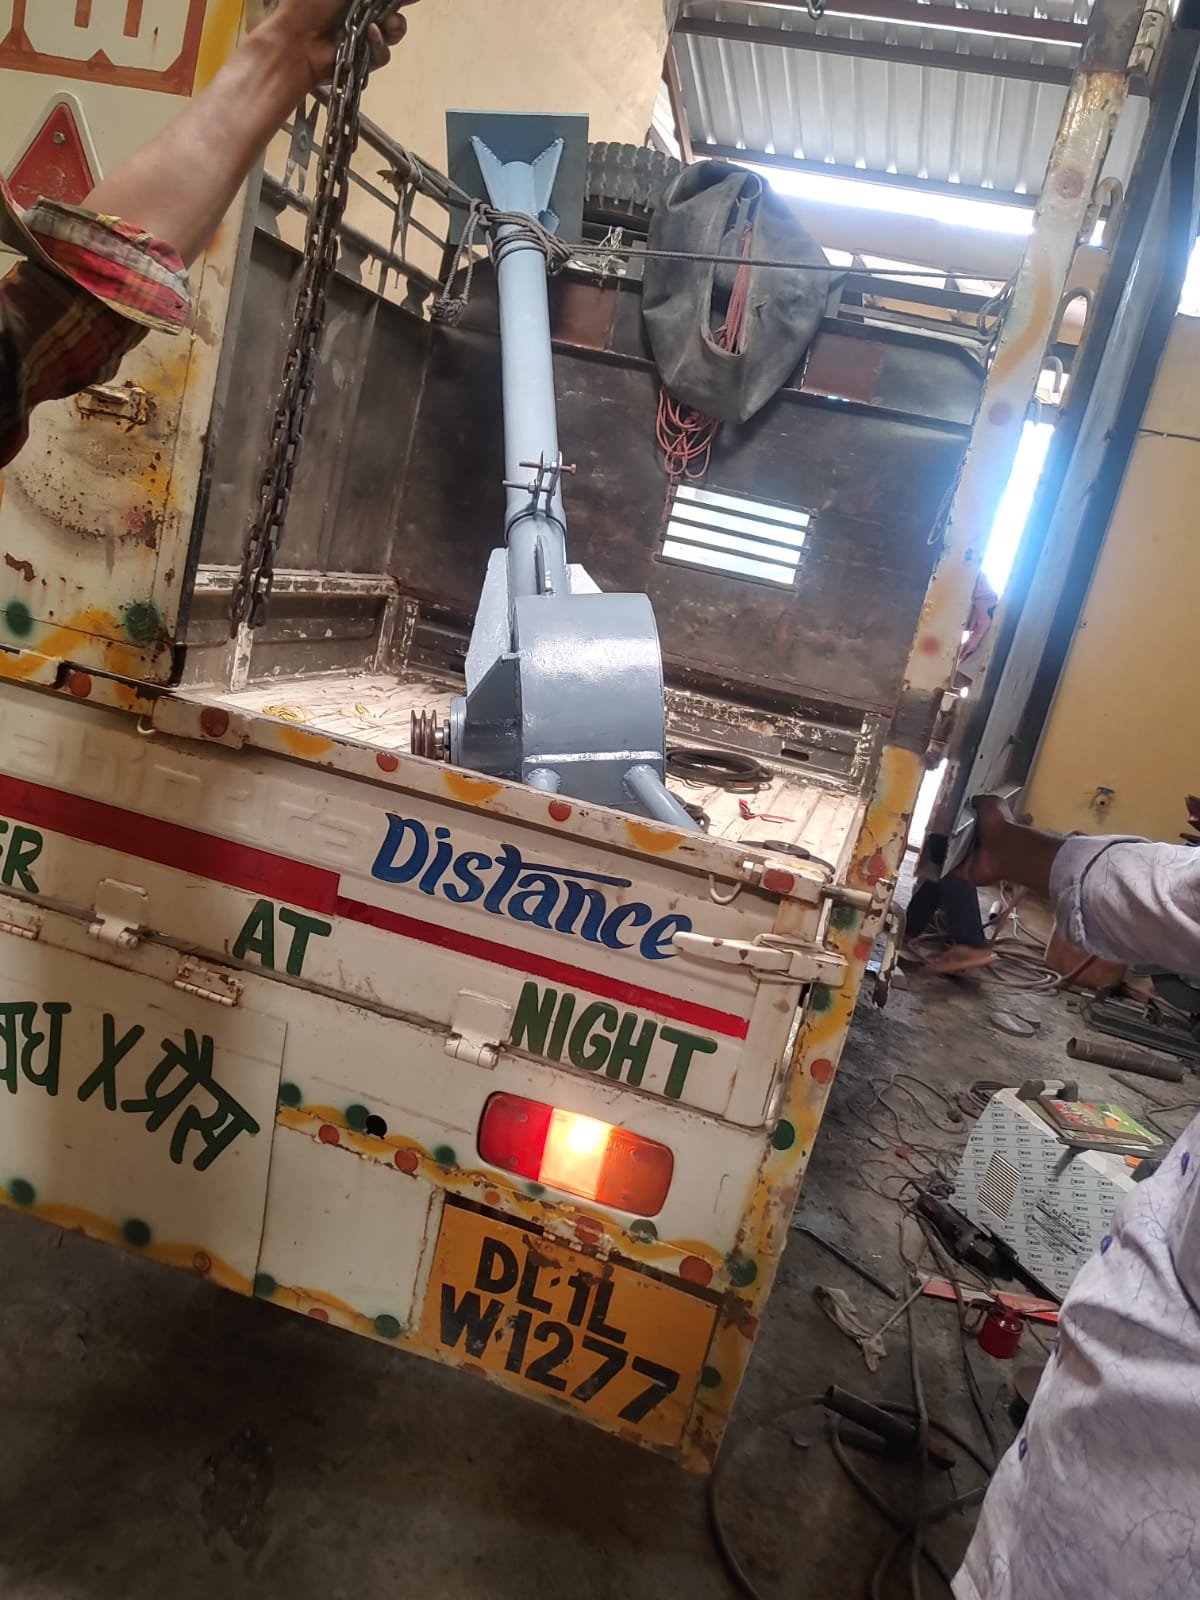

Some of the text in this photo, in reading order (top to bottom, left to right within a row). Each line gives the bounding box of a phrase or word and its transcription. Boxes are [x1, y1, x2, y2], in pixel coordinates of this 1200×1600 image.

[371, 812, 692, 960] Distance
[231, 899, 332, 977] AT
[510, 981, 718, 1099] NIGHT
